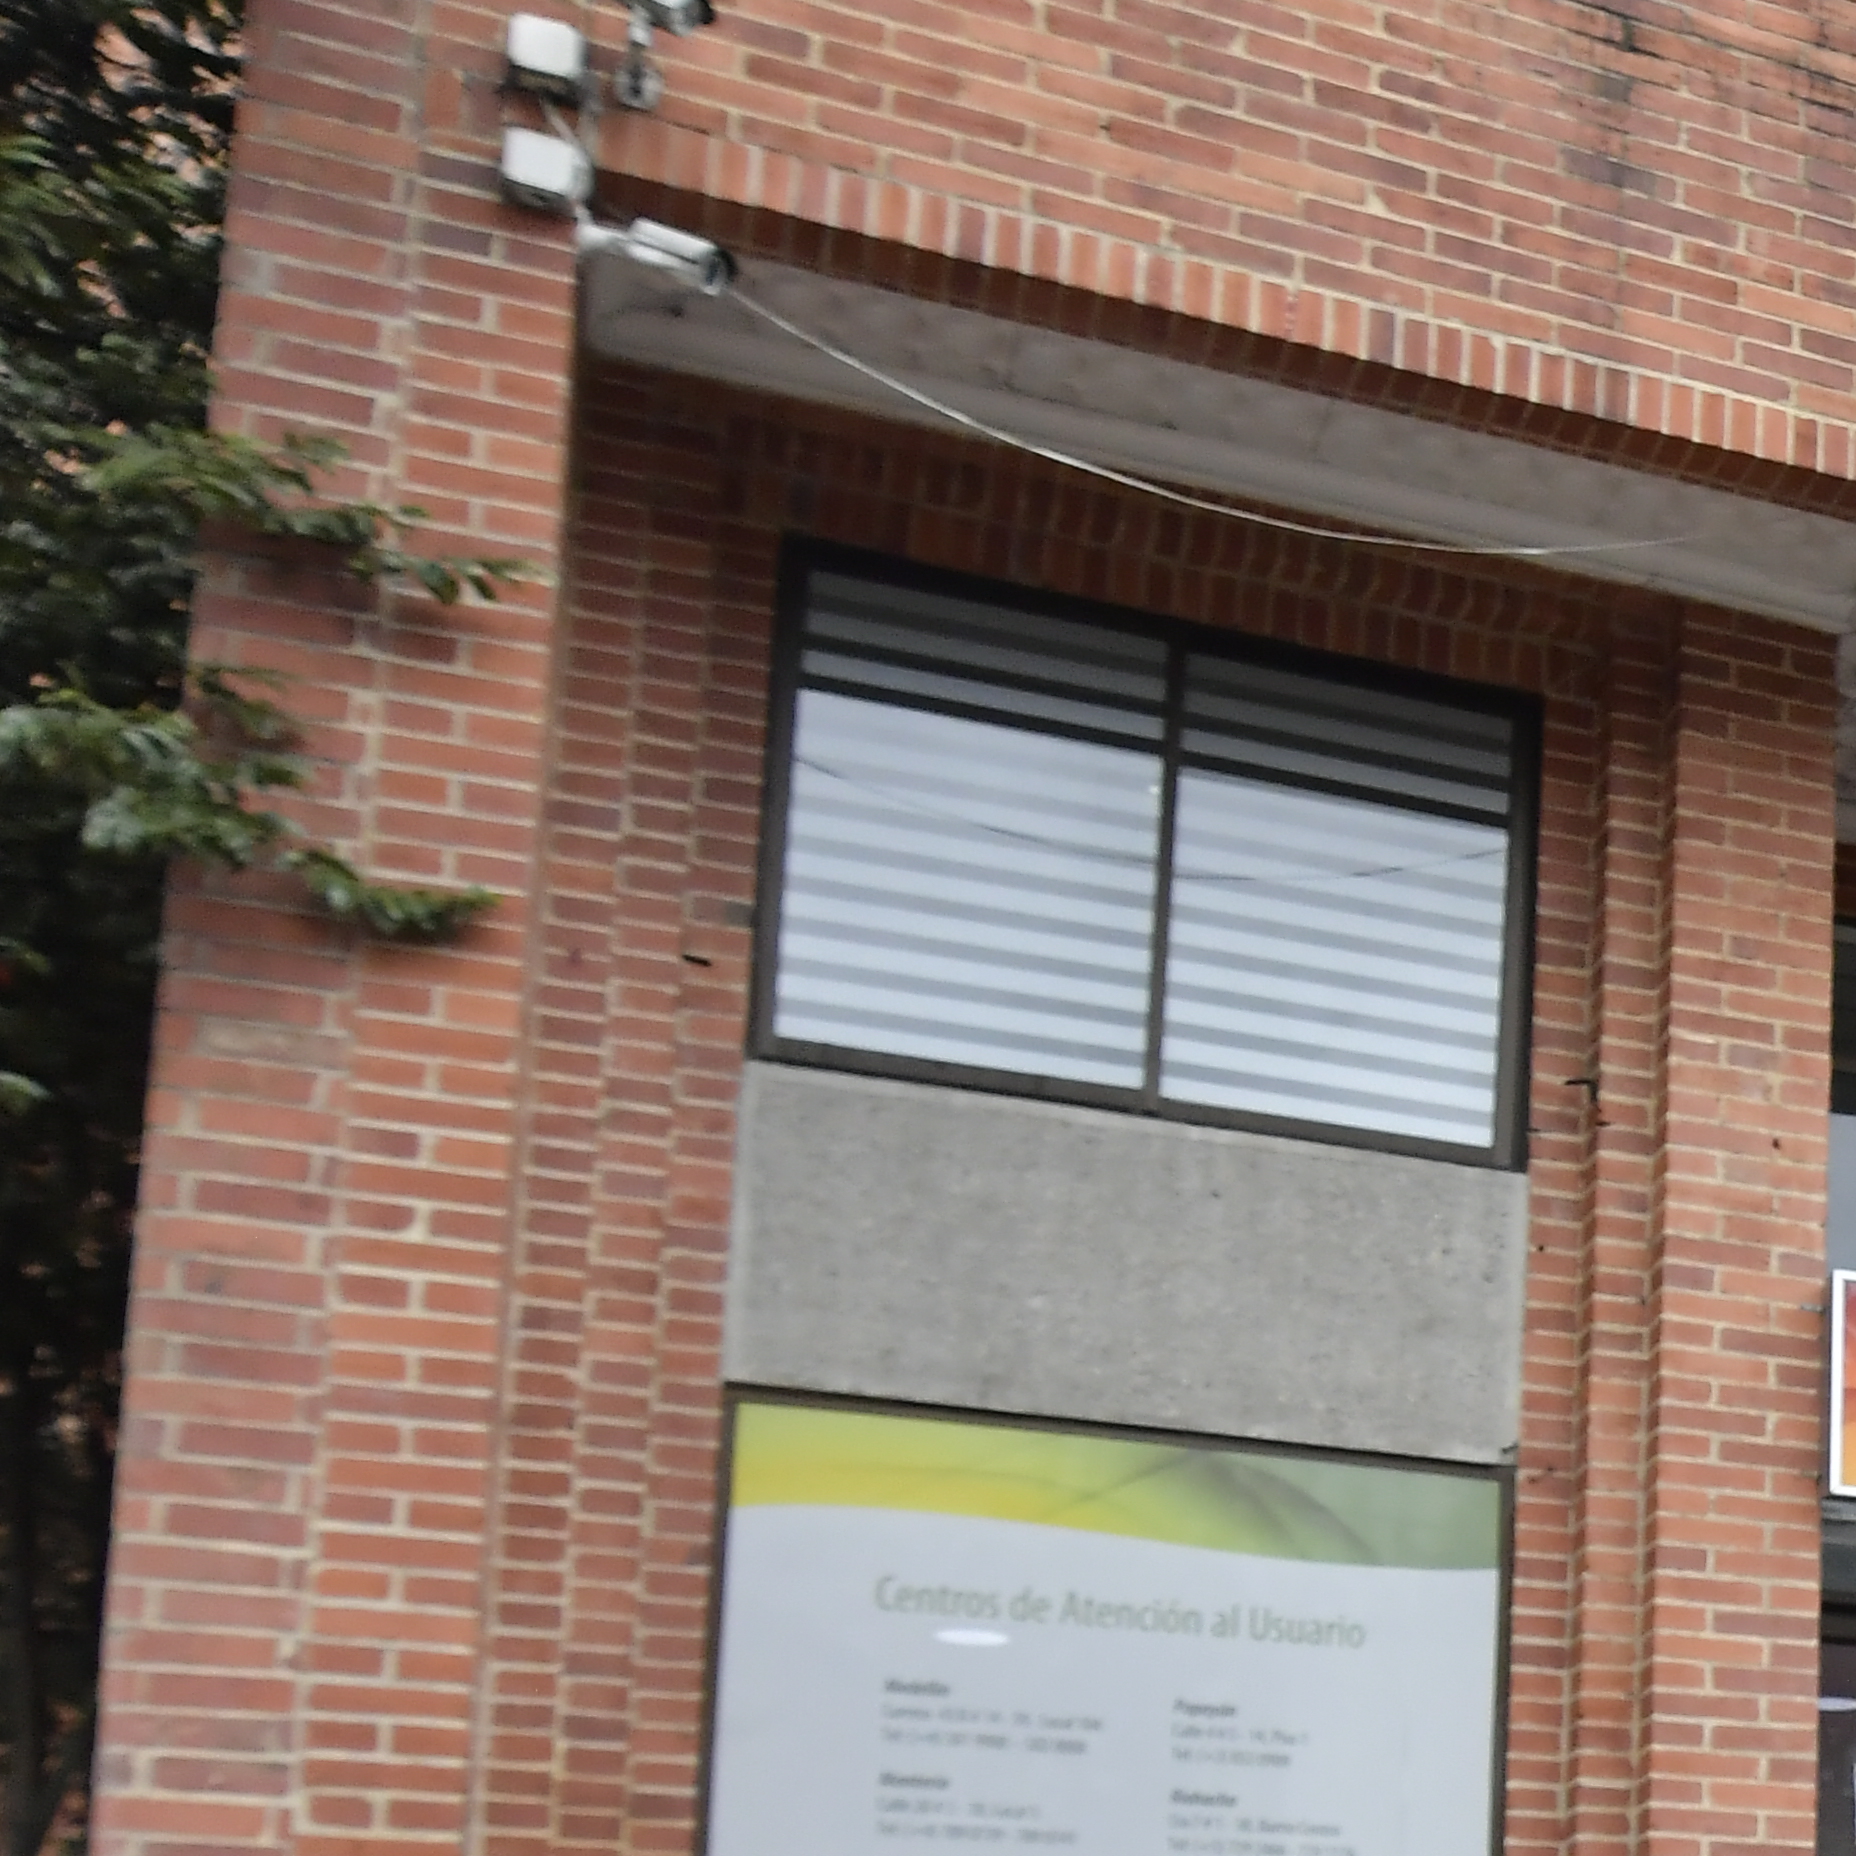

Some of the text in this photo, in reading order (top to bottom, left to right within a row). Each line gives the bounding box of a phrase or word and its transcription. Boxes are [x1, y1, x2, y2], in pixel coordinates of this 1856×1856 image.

[875, 1575, 1366, 1649] Centros de Atención al Usuario
